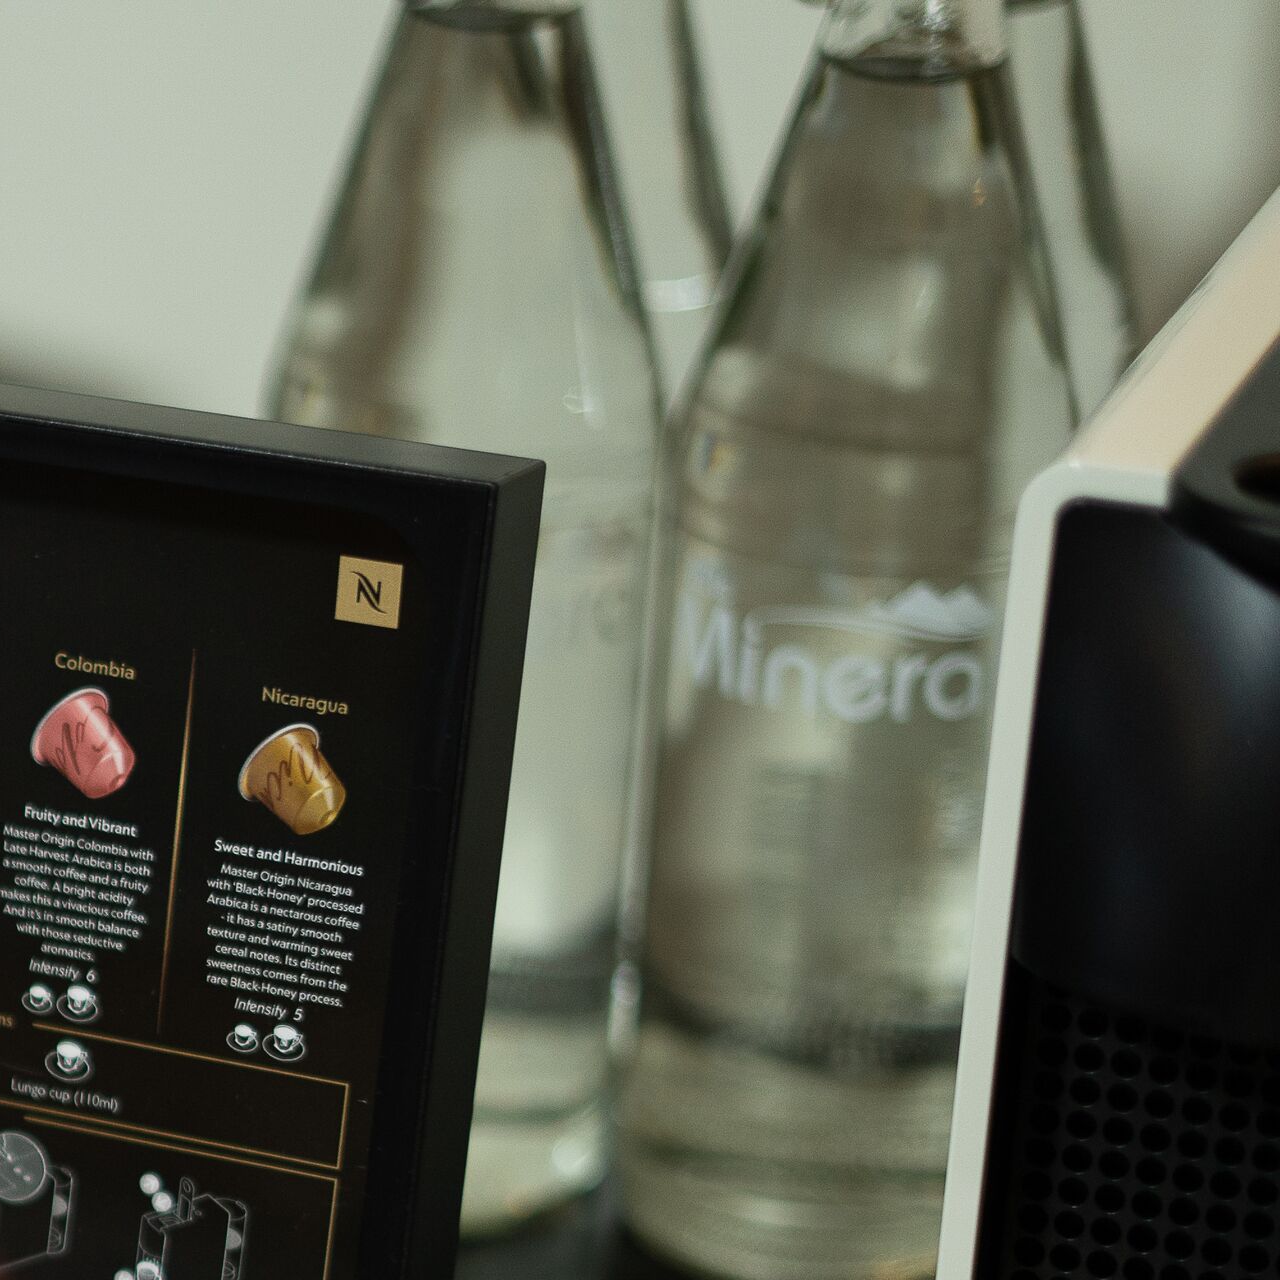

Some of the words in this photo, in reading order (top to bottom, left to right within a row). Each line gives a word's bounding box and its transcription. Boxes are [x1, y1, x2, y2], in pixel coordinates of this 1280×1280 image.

[55, 652, 135, 680] Colombia
[262, 686, 348, 715] Nicaragua
[24, 806, 60, 826] Fruity
[62, 815, 87, 828] and
[89, 817, 136, 837] Vibrant
[3, 825, 39, 841] Master
[41, 832, 75, 848] Origin
[77, 837, 128, 856] Colombia
[130, 848, 153, 860] with
[3, 840, 27, 854] Late
[29, 845, 69, 862] Harvest
[72, 852, 112, 869] Arabica
[114, 860, 122, 871] is
[124, 861, 151, 876] both
[214, 839, 253, 857] Sweet
[256, 849, 282, 862] and
[284, 851, 364, 877] Harmonious
[2, 859, 10, 868] a
[11, 860, 51, 874] smooth
[53, 867, 87, 881] coffee
[89, 873, 109, 884] and
[111, 877, 118, 886] a
[120, 876, 148, 894] fruity
[14, 876, 49, 890] coffee.
[52, 880, 61, 892] A
[63, 882, 95, 898] bright
[98, 890, 134, 907] acidity
[220, 863, 258, 880] Master
[260, 870, 294, 887] Origin
[297, 876, 352, 897] Nicaragua
[32, 894, 51, 906] this
[53, 899, 60, 908] a
[62, 899, 109, 916] vivacious
[111, 909, 147, 923] coffee.
[207, 879, 231, 892] with
[308, 897, 363, 914] processed
[207, 894, 248, 910] Arabica
[250, 901, 258, 912] is
[260, 905, 268, 914] a
[270, 907, 322, 923] nectarous
[324, 916, 360, 929] coffee
[3, 902, 26, 916] And
[27, 907, 41, 919] it's
[44, 910, 53, 922] in
[55, 914, 95, 929] smooth
[98, 920, 140, 937] balance
[16, 922, 39, 935] with
[41, 926, 70, 941] those
[73, 933, 123, 950] seductive
[227, 912, 235, 924] it
[237, 914, 255, 928] has
[257, 920, 264, 929] a
[266, 922, 298, 938] satiny
[300, 928, 342, 942] smooth
[41, 944, 94, 961] aromatics.
[207, 926, 246, 942] texture
[247, 935, 269, 946] and
[271, 939, 318, 957] warming
[320, 947, 353, 961] sweet
[215, 945, 247, 958] cereal
[250, 951, 282, 964] notes.
[285, 955, 298, 967] Its
[300, 957, 341, 975] distinct
[29, 959, 79, 982] Intensity
[86, 969, 95, 983] 6
[206, 959, 261, 976] sweetness
[263, 969, 298, 983] comes
[300, 973, 326, 988] from
[328, 979, 347, 992] the
[206, 974, 228, 986] rare
[230, 976, 296, 1001] Black-Honey
[299, 991, 343, 1007] process.
[234, 997, 286, 1021] Intensity
[293, 1007, 303, 1021] 5
[11, 1078, 45, 1097] Lungo
[50, 1089, 70, 1102] cup
[74, 1089, 118, 1111] (110ml)
